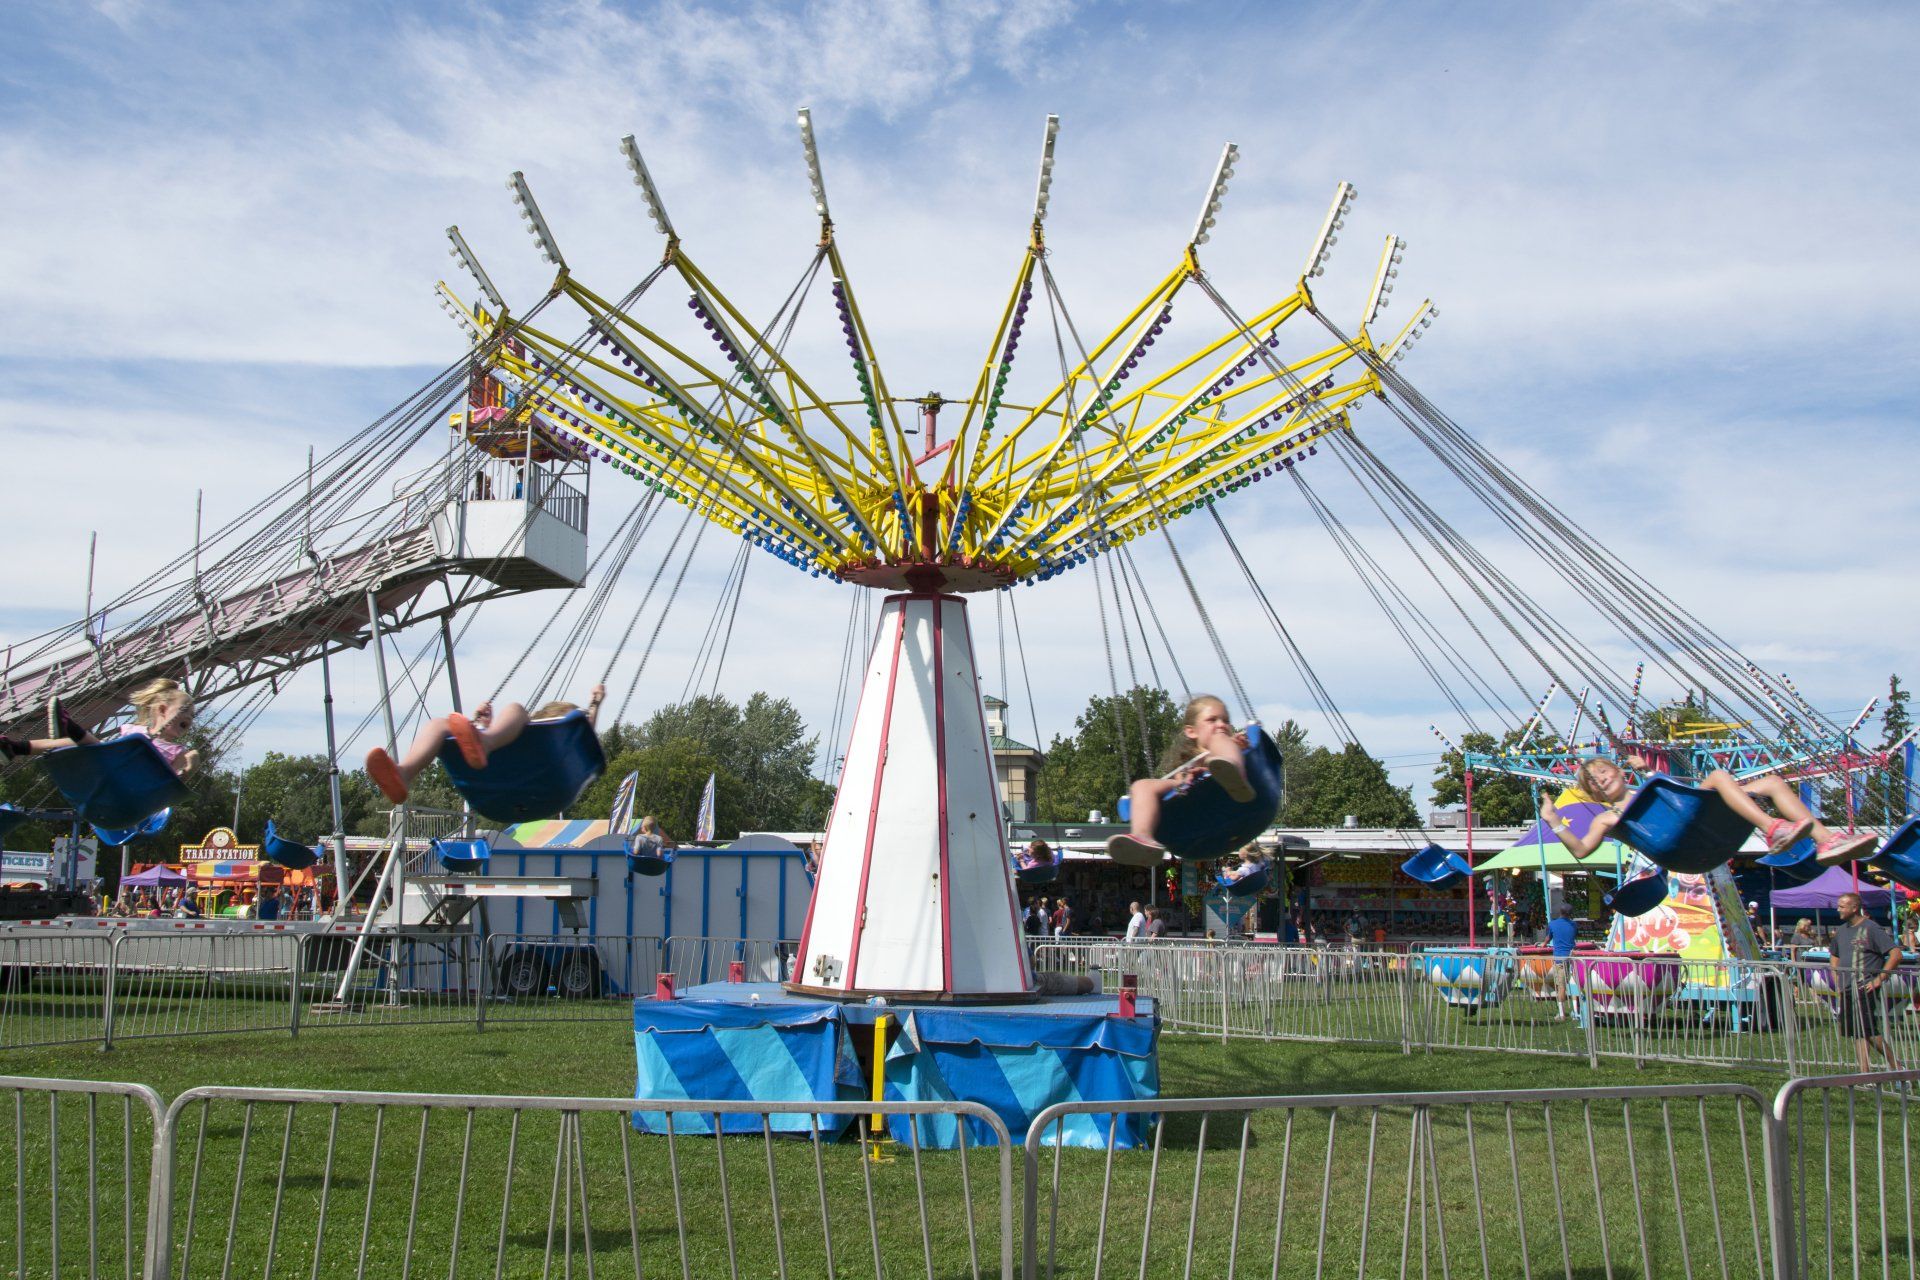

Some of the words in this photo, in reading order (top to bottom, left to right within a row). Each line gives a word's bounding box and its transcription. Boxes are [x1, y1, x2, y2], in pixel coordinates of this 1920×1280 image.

[186, 849, 214, 859] TRAIN
[216, 849, 254, 860] STATION
[2, 856, 44, 867] TICKETS
